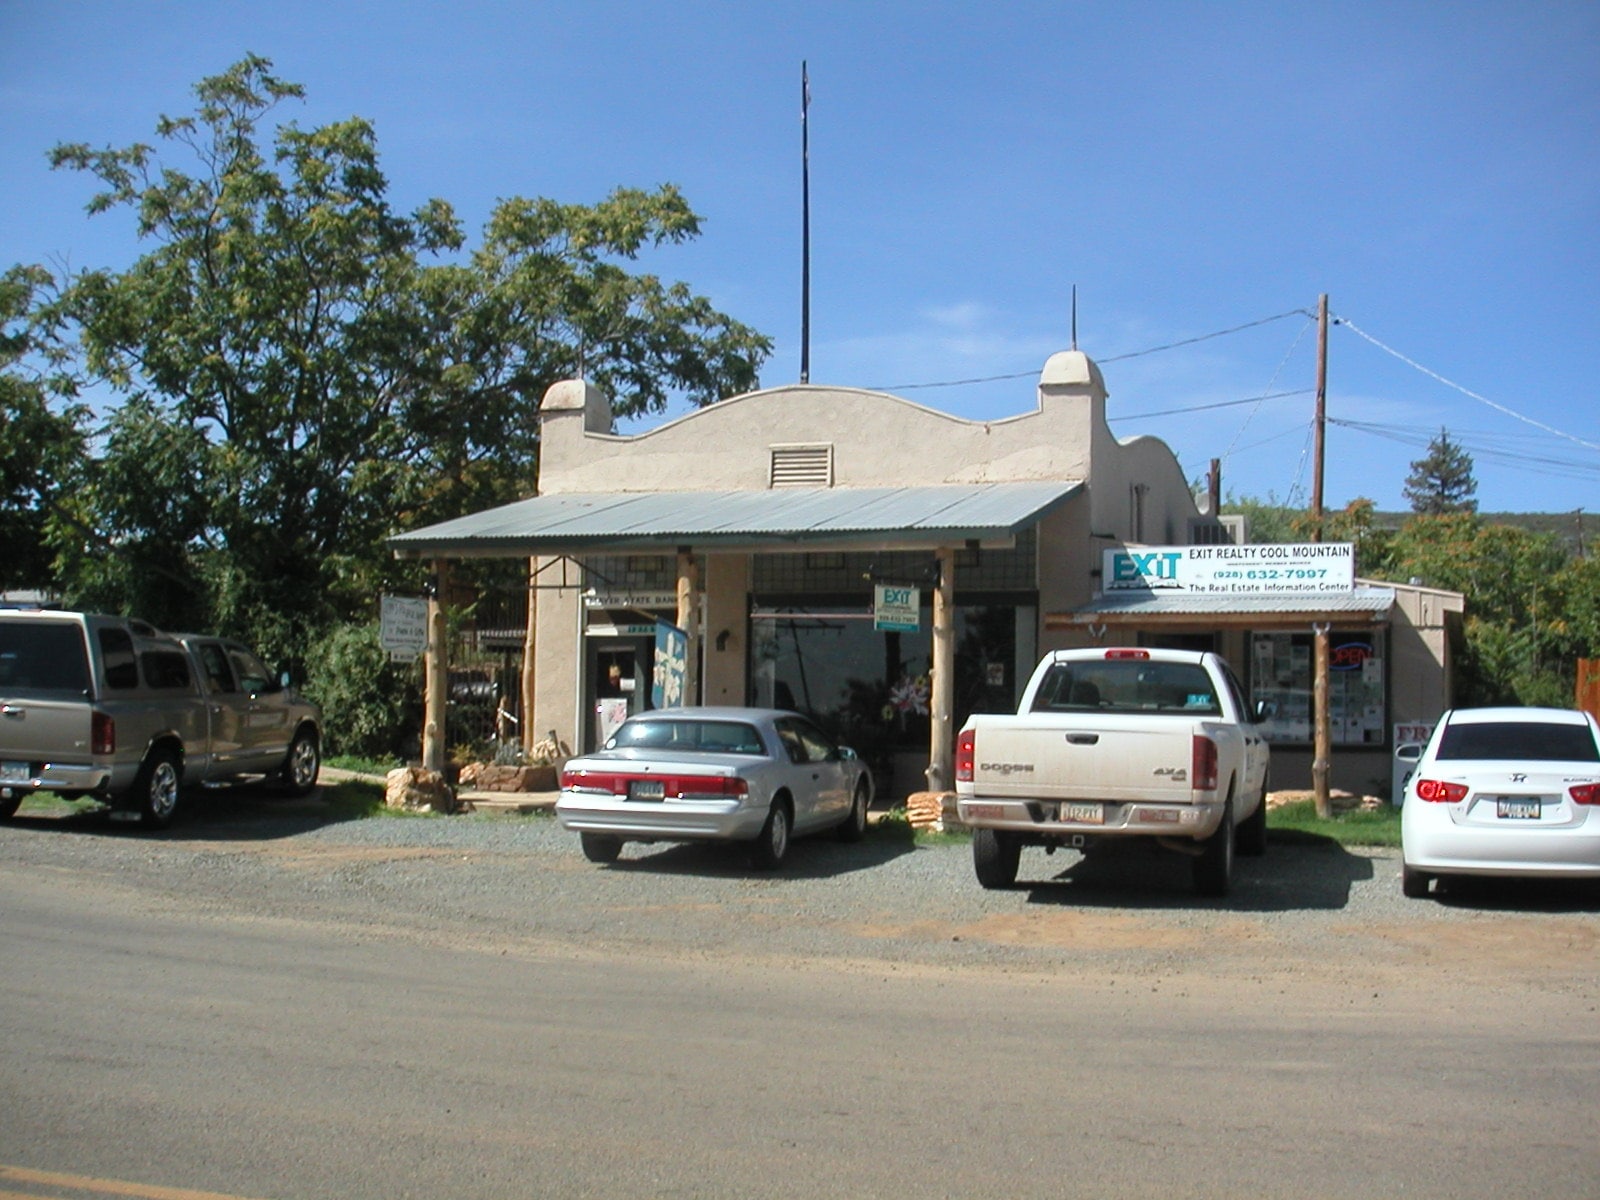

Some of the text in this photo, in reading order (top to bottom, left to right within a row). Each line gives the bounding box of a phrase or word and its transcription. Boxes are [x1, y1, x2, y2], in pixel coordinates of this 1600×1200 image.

[1189, 546, 1350, 559] EXIT REALTY COOL MOUNTAIN
[1213, 569, 1327, 579] (928) 632-7997
[1189, 582, 1349, 592] The Real Estate Information Center
